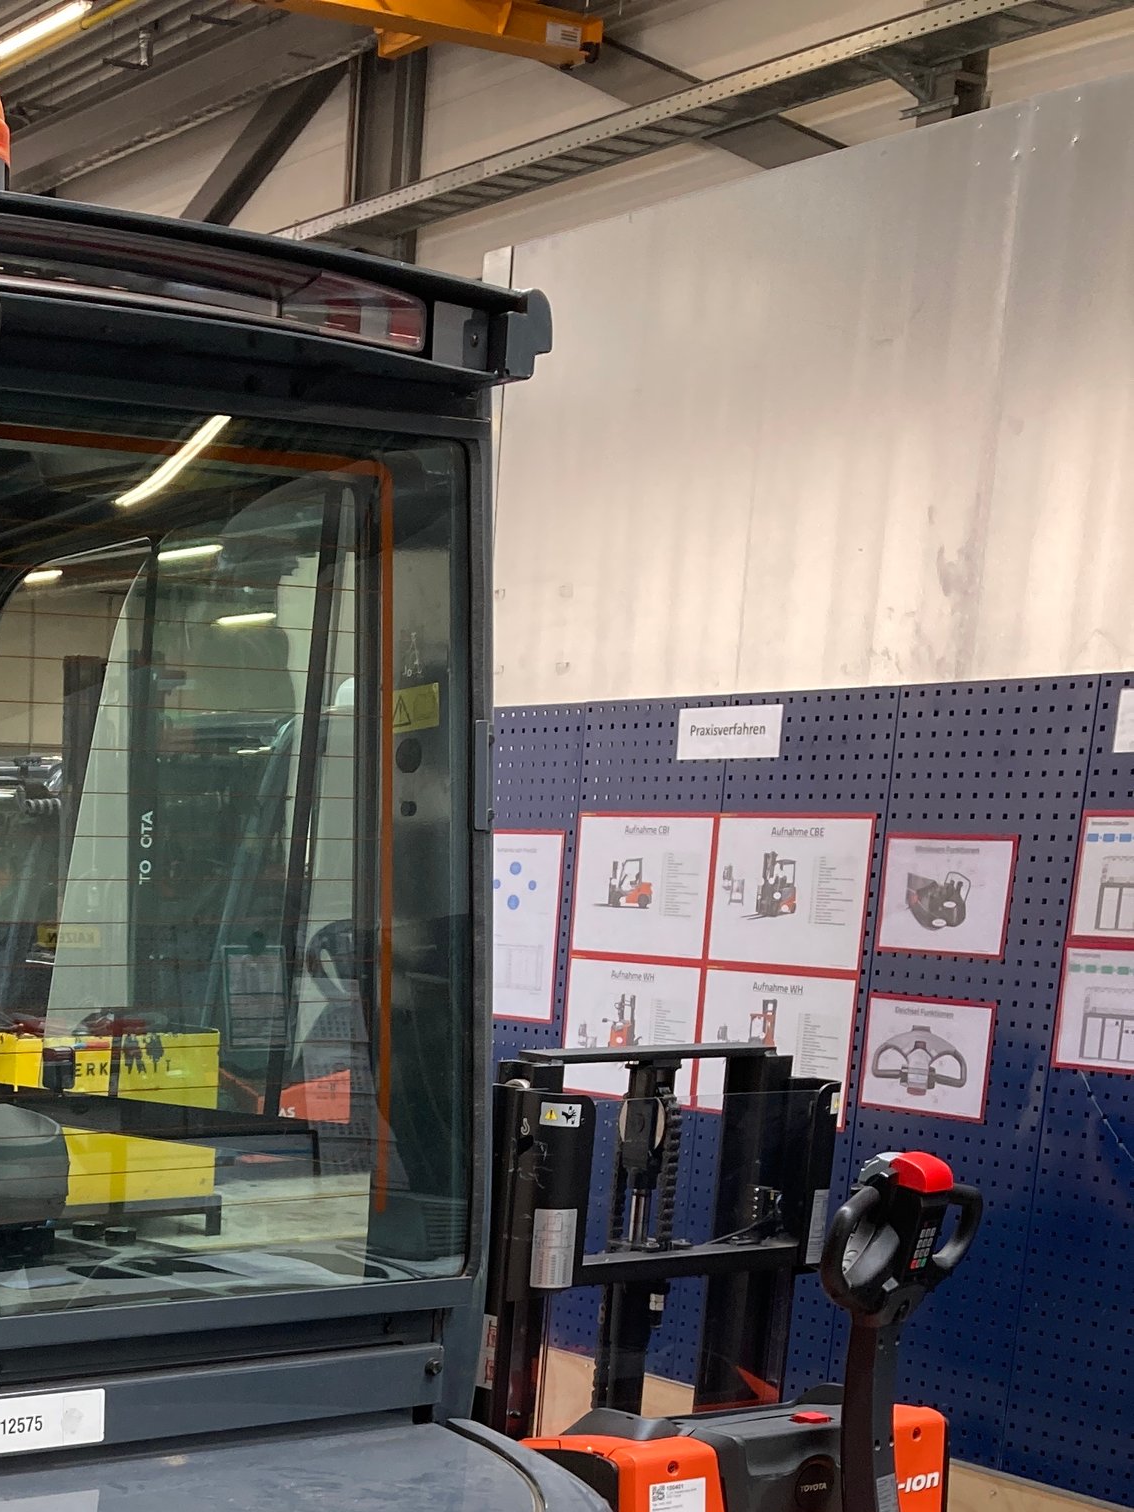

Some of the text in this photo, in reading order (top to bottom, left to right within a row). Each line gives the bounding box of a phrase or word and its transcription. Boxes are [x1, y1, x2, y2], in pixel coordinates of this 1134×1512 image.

[689, 722, 766, 737] Praxisverfahren
[624, 825, 657, 835] Aufnahme
[771, 827, 825, 837] Aufnahme CBE
[138, 811, 154, 886] TOOTA
[611, 969, 655, 982] Aufnahme WH
[752, 982, 804, 996] Aufnahme WH
[800, 1482, 827, 1493] TOYOTA
